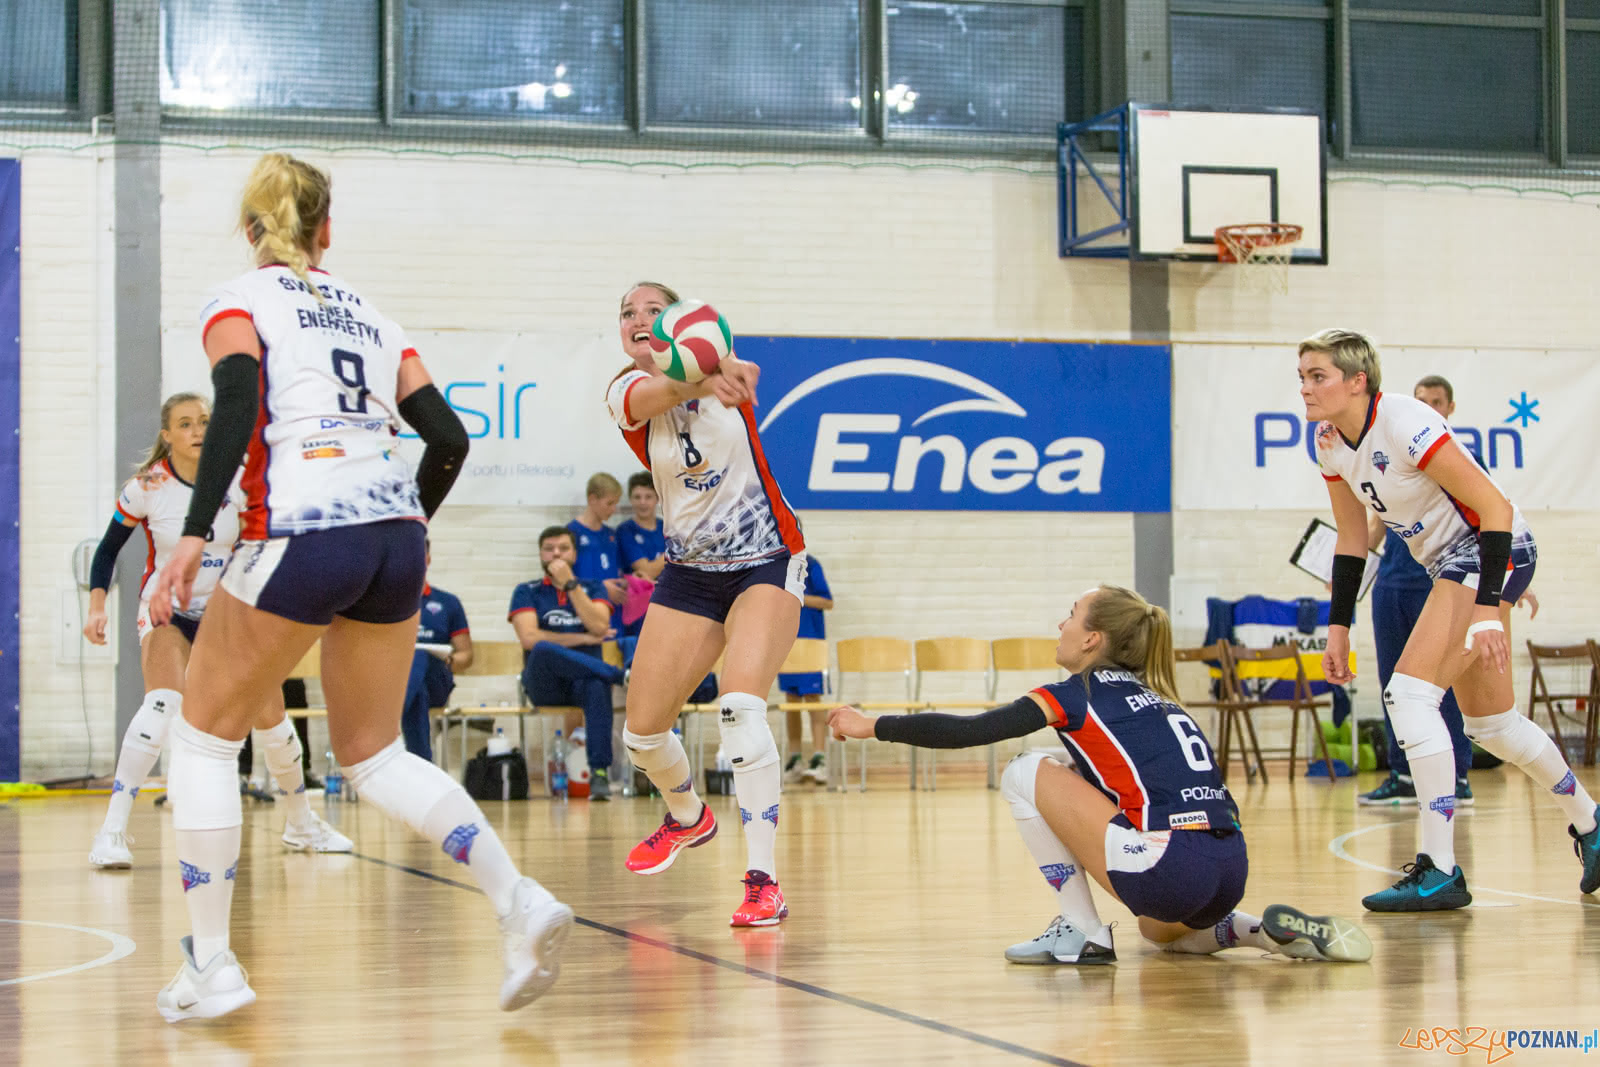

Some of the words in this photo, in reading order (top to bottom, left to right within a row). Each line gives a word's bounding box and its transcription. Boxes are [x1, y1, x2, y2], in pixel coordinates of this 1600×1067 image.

[331, 347, 368, 414] 9
[808, 413, 1106, 494] Enea
[1412, 426, 1431, 444] Enea
[1360, 481, 1387, 513] 3
[1167, 714, 1213, 772] 6
[1171, 815, 1207, 825] AKROPOL
